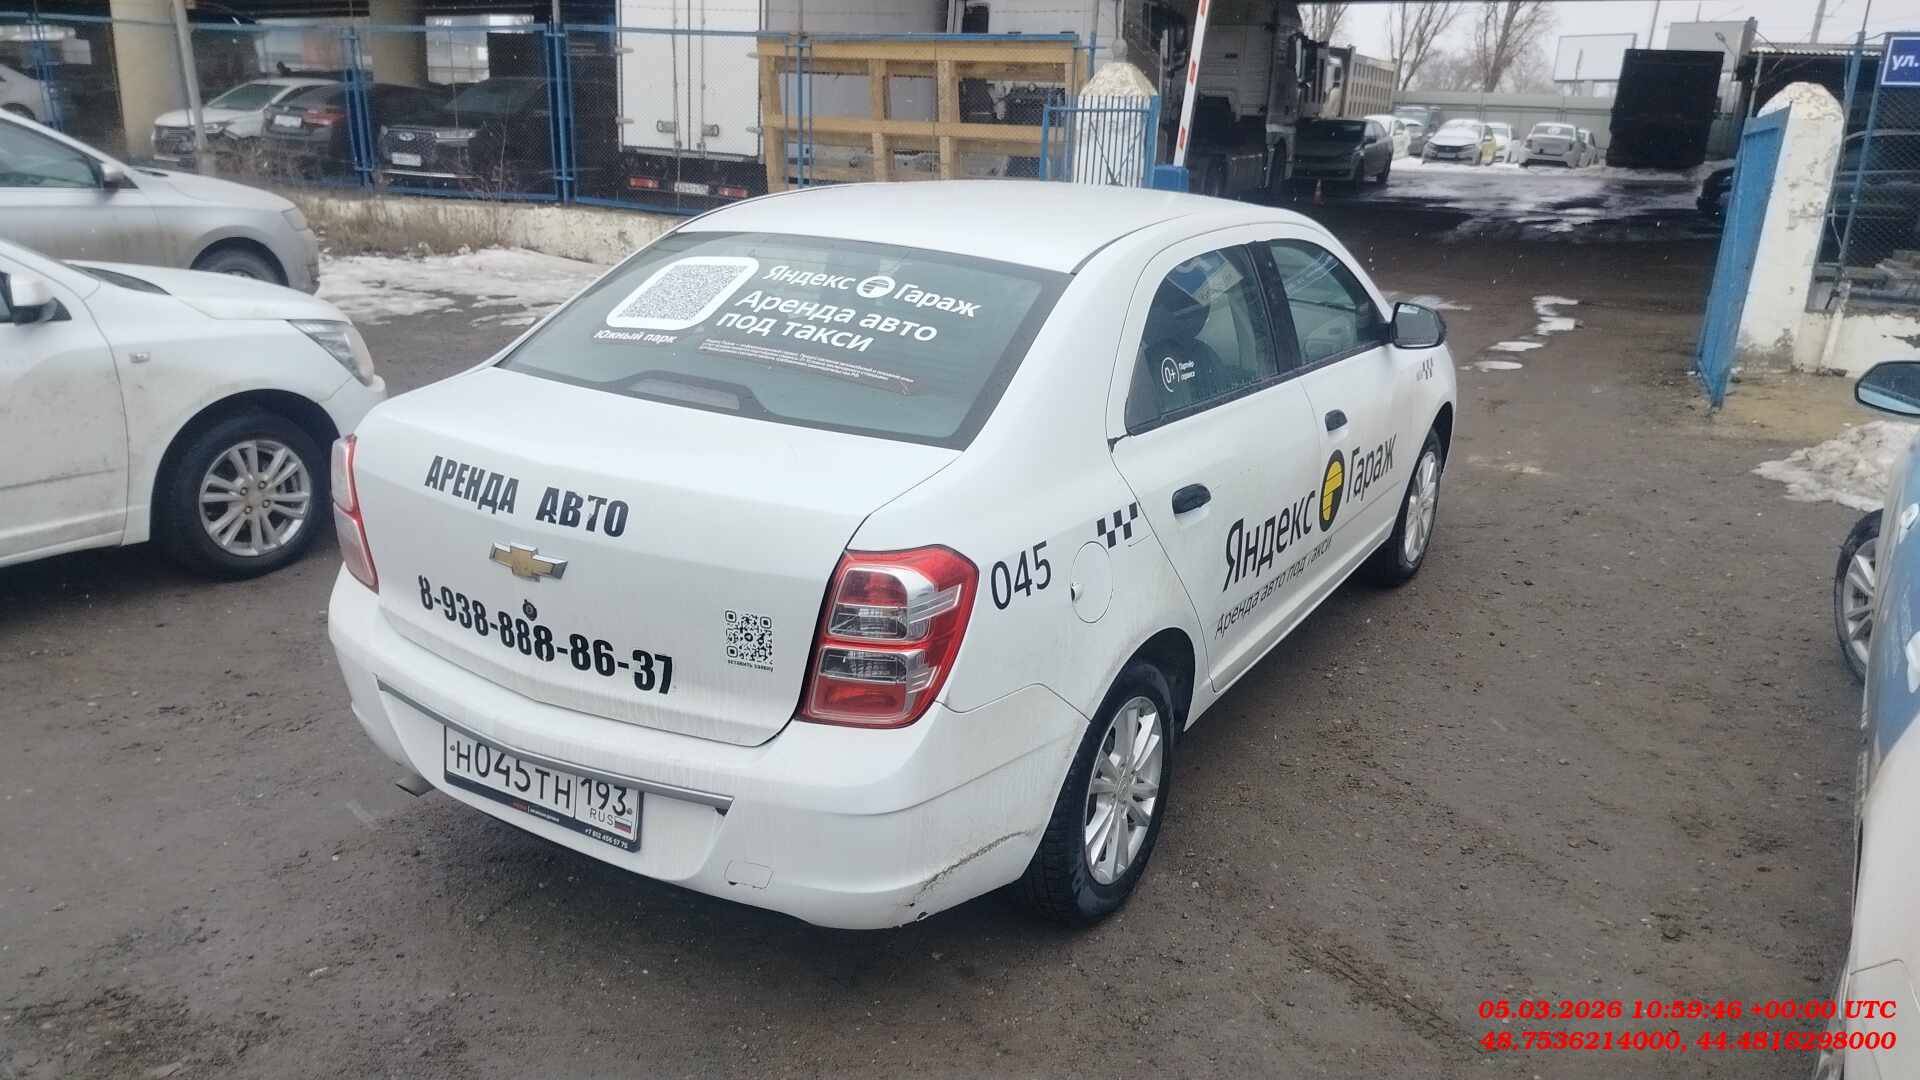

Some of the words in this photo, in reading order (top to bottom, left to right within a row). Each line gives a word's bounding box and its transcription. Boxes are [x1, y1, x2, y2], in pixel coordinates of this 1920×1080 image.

[1892, 55, 1919, 71] ул.
[736, 290, 857, 325] Аренда
[858, 310, 939, 343] авто
[761, 265, 857, 291] Яндекс
[893, 283, 983, 319] Гараж
[593, 329, 645, 341] Южный
[644, 333, 678, 345] парк
[715, 311, 777, 337] под
[781, 319, 876, 353] такси
[1164, 367, 1176, 384] 0+
[424, 455, 519, 515] АРЕНДА
[536, 486, 629, 537] АВТО
[1223, 490, 1315, 592] Яндекс
[1346, 433, 1397, 503] Гараж
[991, 540, 1051, 610] 045
[1215, 591, 1260, 641] Аренда
[1260, 572, 1287, 602] авто
[1286, 555, 1308, 582] под
[418, 574, 673, 695] 8-938-888-86-37
[580, 778, 628, 816] 193
[589, 807, 614, 826] RUS
